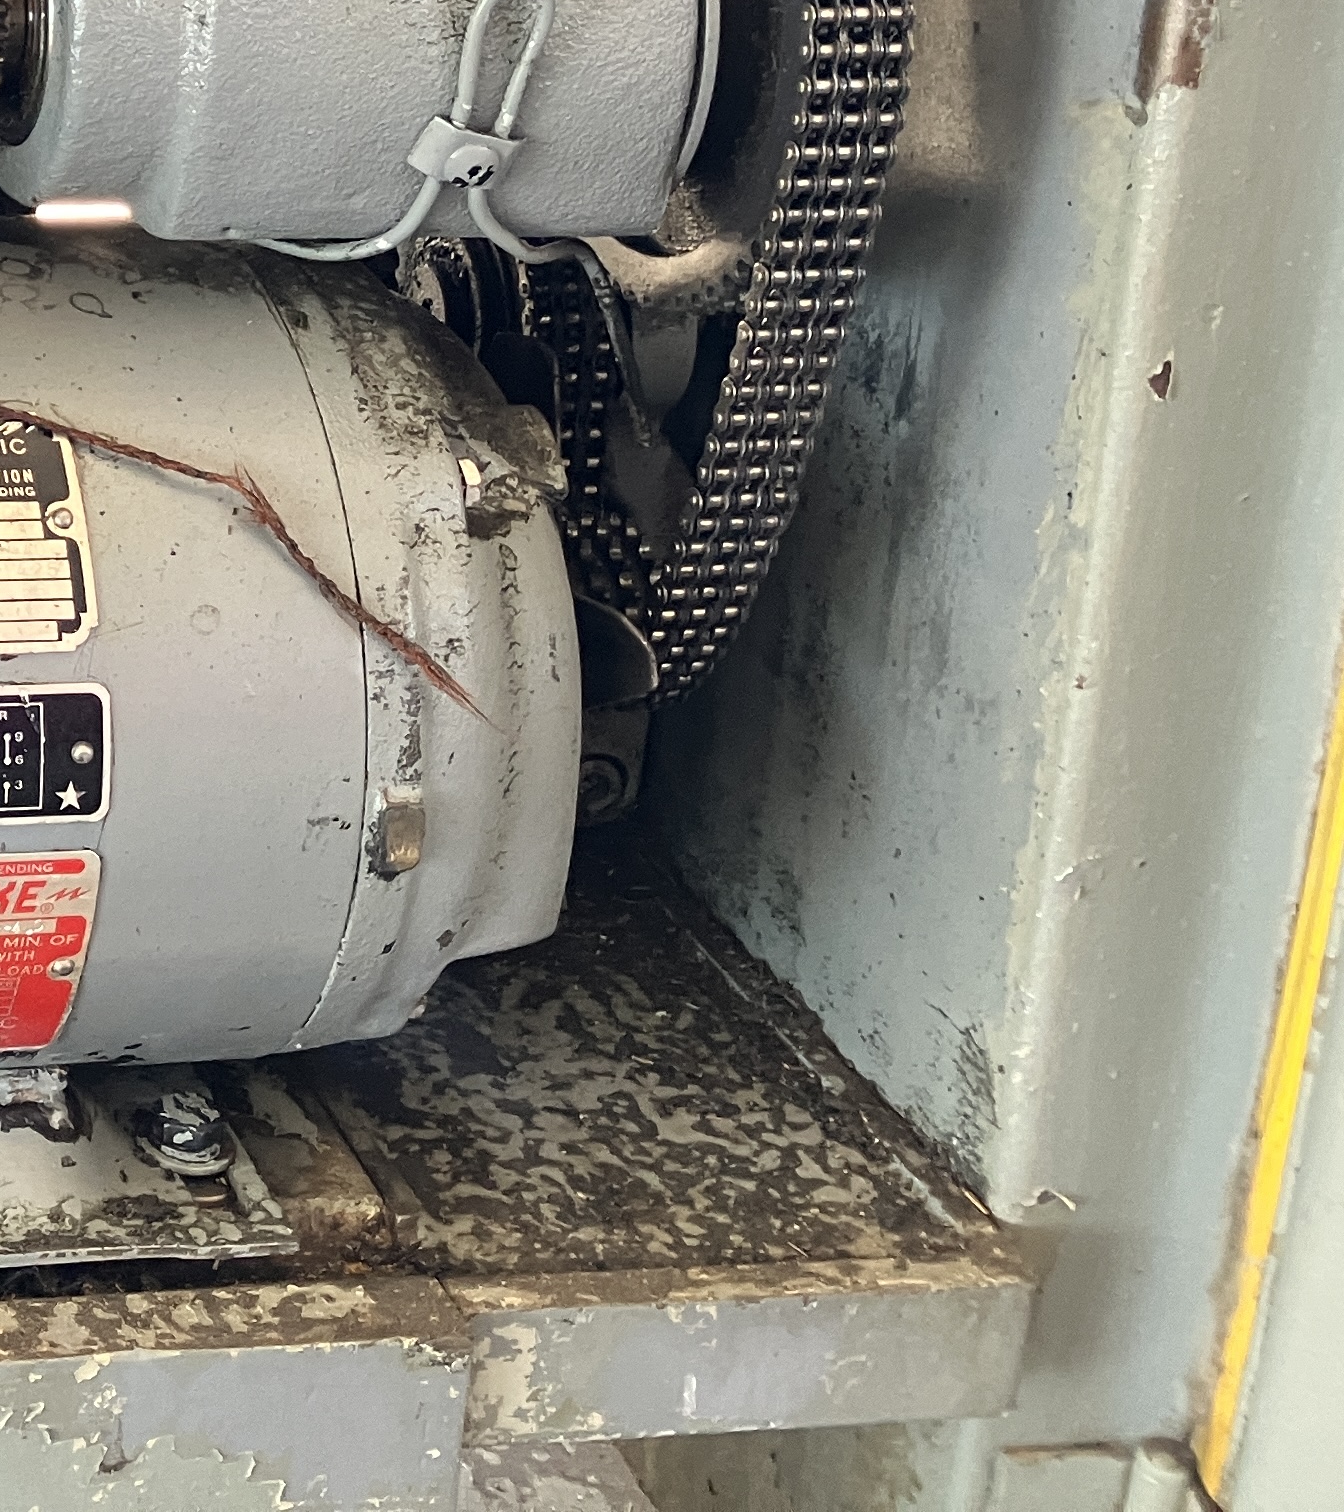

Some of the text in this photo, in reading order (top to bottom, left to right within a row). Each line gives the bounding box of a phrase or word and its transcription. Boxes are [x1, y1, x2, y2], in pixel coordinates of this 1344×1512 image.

[14, 754, 24, 765] 6
[14, 779, 23, 790] 3
[49, 934, 79, 947] OF
